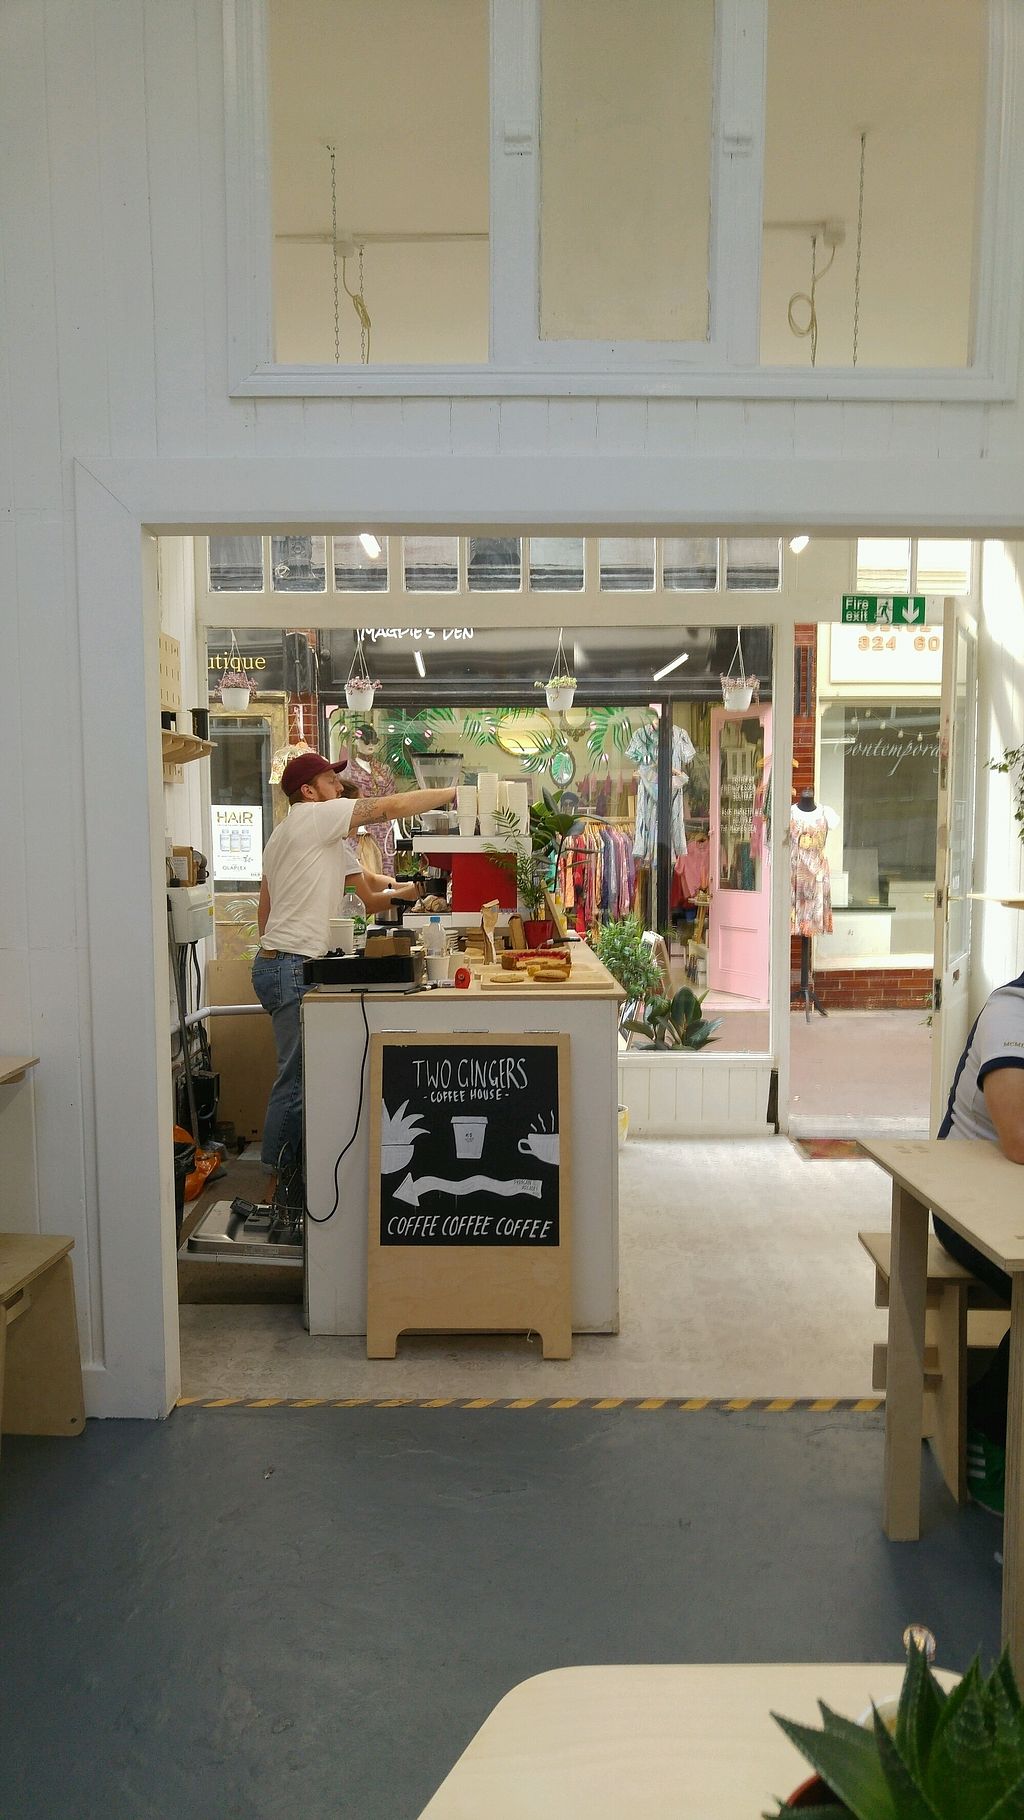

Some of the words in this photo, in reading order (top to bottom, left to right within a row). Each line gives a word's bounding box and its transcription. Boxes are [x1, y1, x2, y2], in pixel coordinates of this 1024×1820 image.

[846, 597, 869, 610] Fire
[846, 611, 868, 622] exit
[216, 811, 254, 824] HAIR
[412, 1059, 452, 1089] TWO
[457, 1057, 528, 1090] GINGERS
[387, 1215, 441, 1237] COFFEE
[441, 1215, 494, 1236] COFFEE
[495, 1217, 553, 1238] COFFEE
